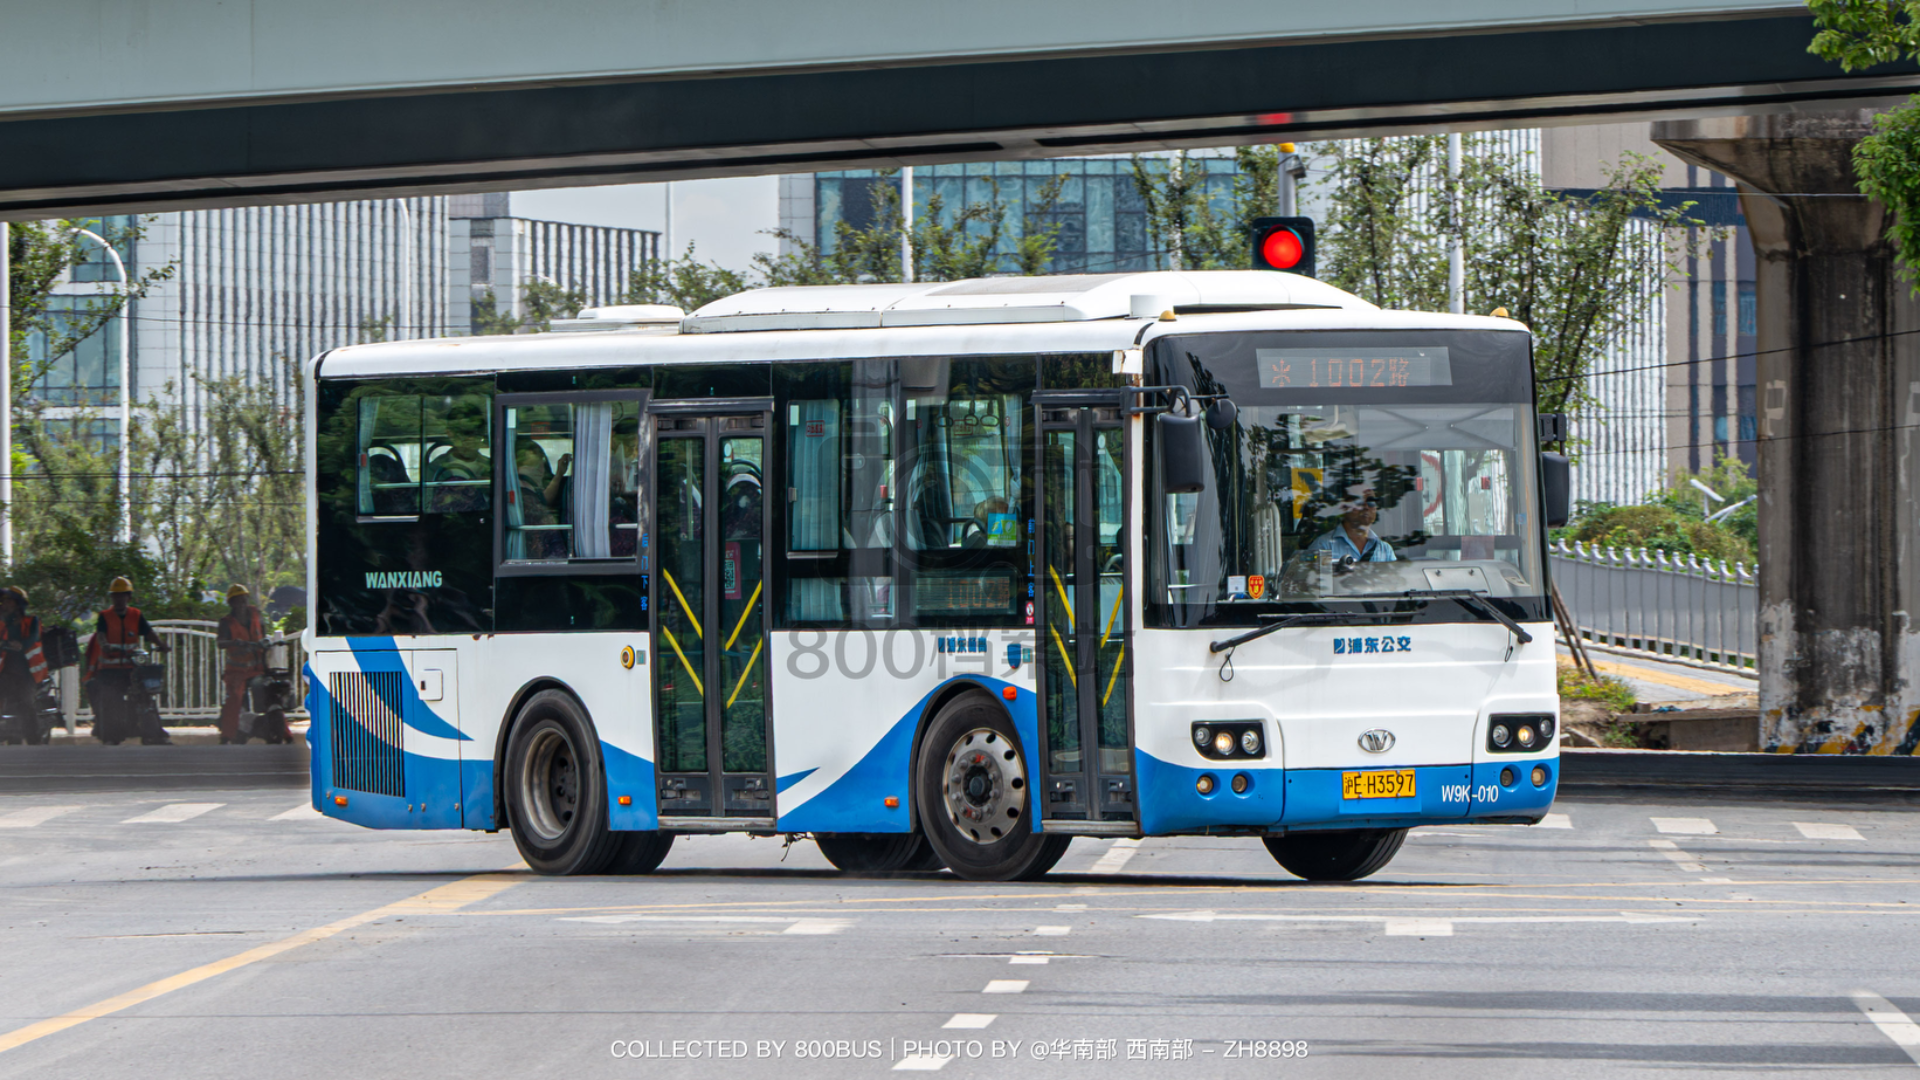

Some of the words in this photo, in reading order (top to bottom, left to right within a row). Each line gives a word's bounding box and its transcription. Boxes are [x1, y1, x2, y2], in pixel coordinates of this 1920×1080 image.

[365, 571, 443, 589] WANXIANG
[1347, 636, 1411, 655] 浦东公交
[1441, 785, 1499, 803] W9K-010
